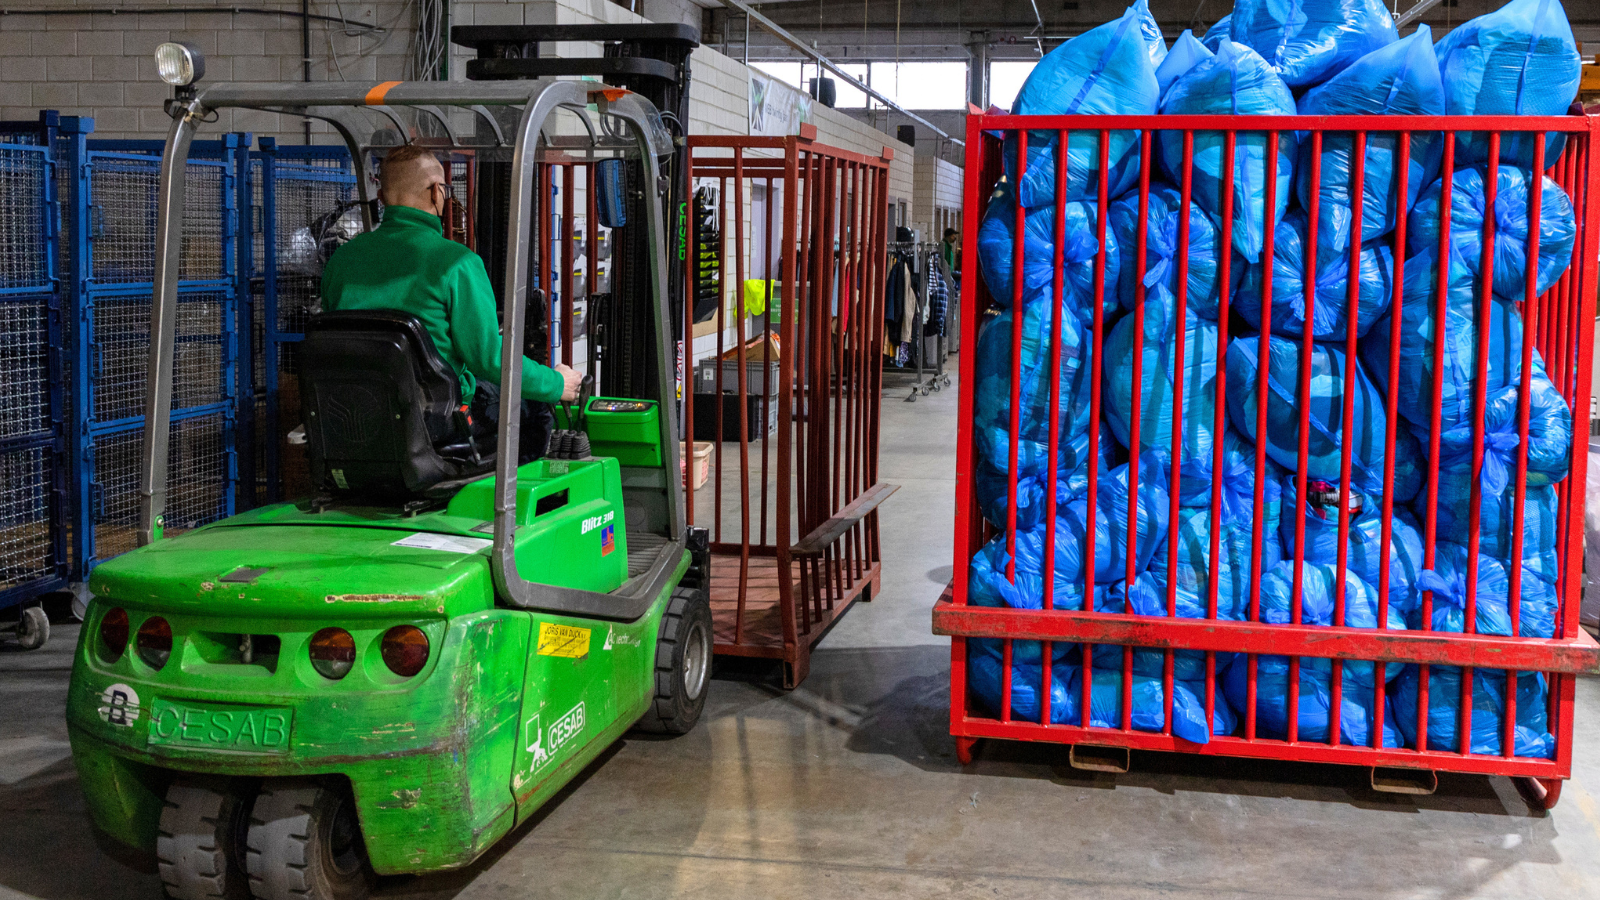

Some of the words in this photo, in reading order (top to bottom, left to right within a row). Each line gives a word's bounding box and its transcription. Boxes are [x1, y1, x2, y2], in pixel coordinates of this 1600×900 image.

[581, 515, 602, 535] Blitz
[602, 510, 615, 524] 318
[155, 706, 286, 747] CESAB
[549, 707, 584, 749] CESAB
